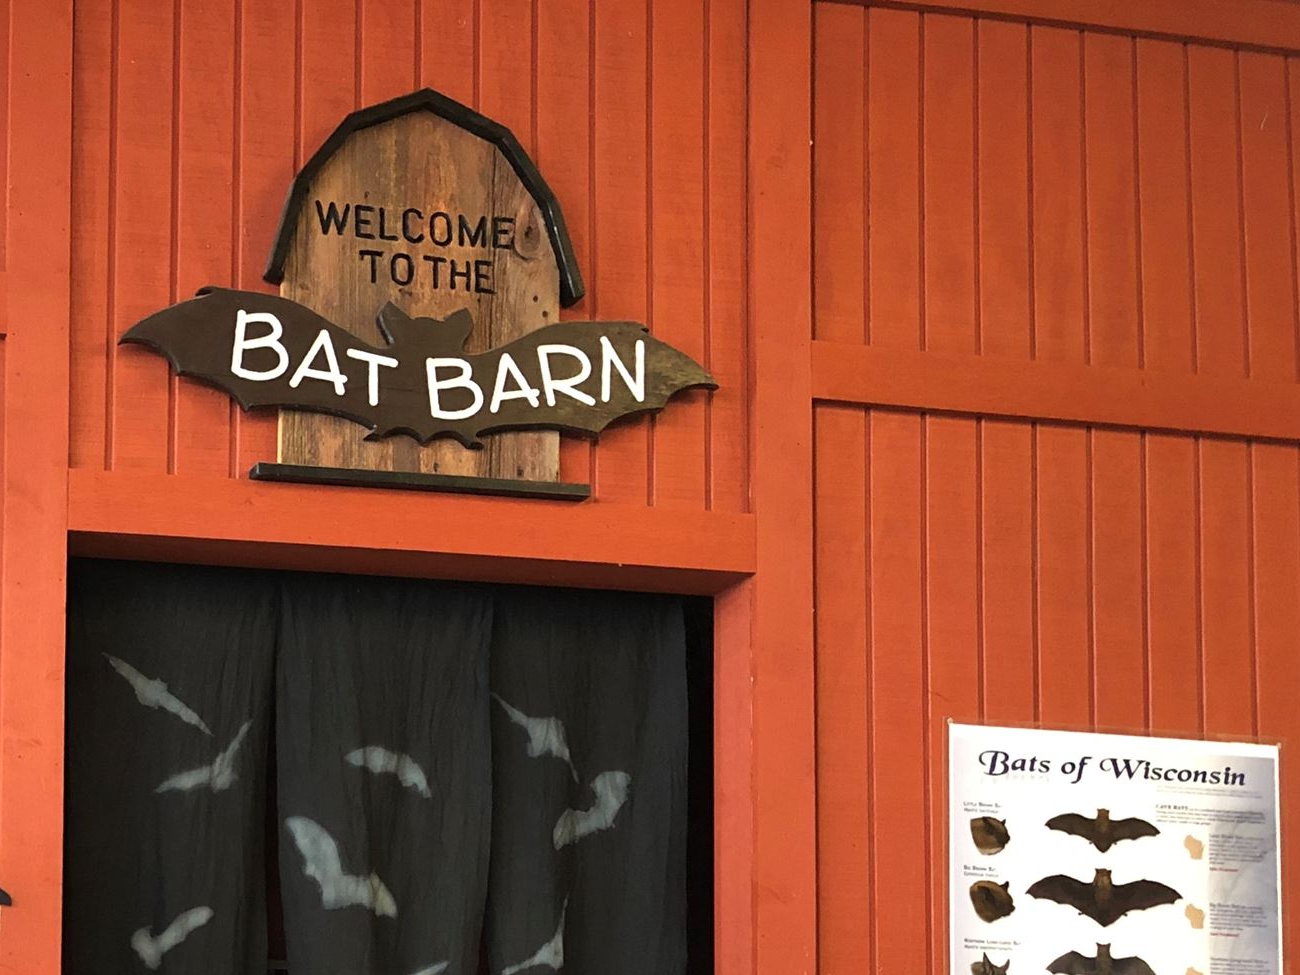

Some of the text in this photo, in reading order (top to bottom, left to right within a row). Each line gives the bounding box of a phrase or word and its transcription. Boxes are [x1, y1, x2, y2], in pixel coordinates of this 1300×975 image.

[315, 200, 515, 250] WELCOME
[359, 250, 497, 294] TO THE
[230, 309, 645, 420] BAT BARN
[978, 750, 1246, 787] Bats of Wisconsin
